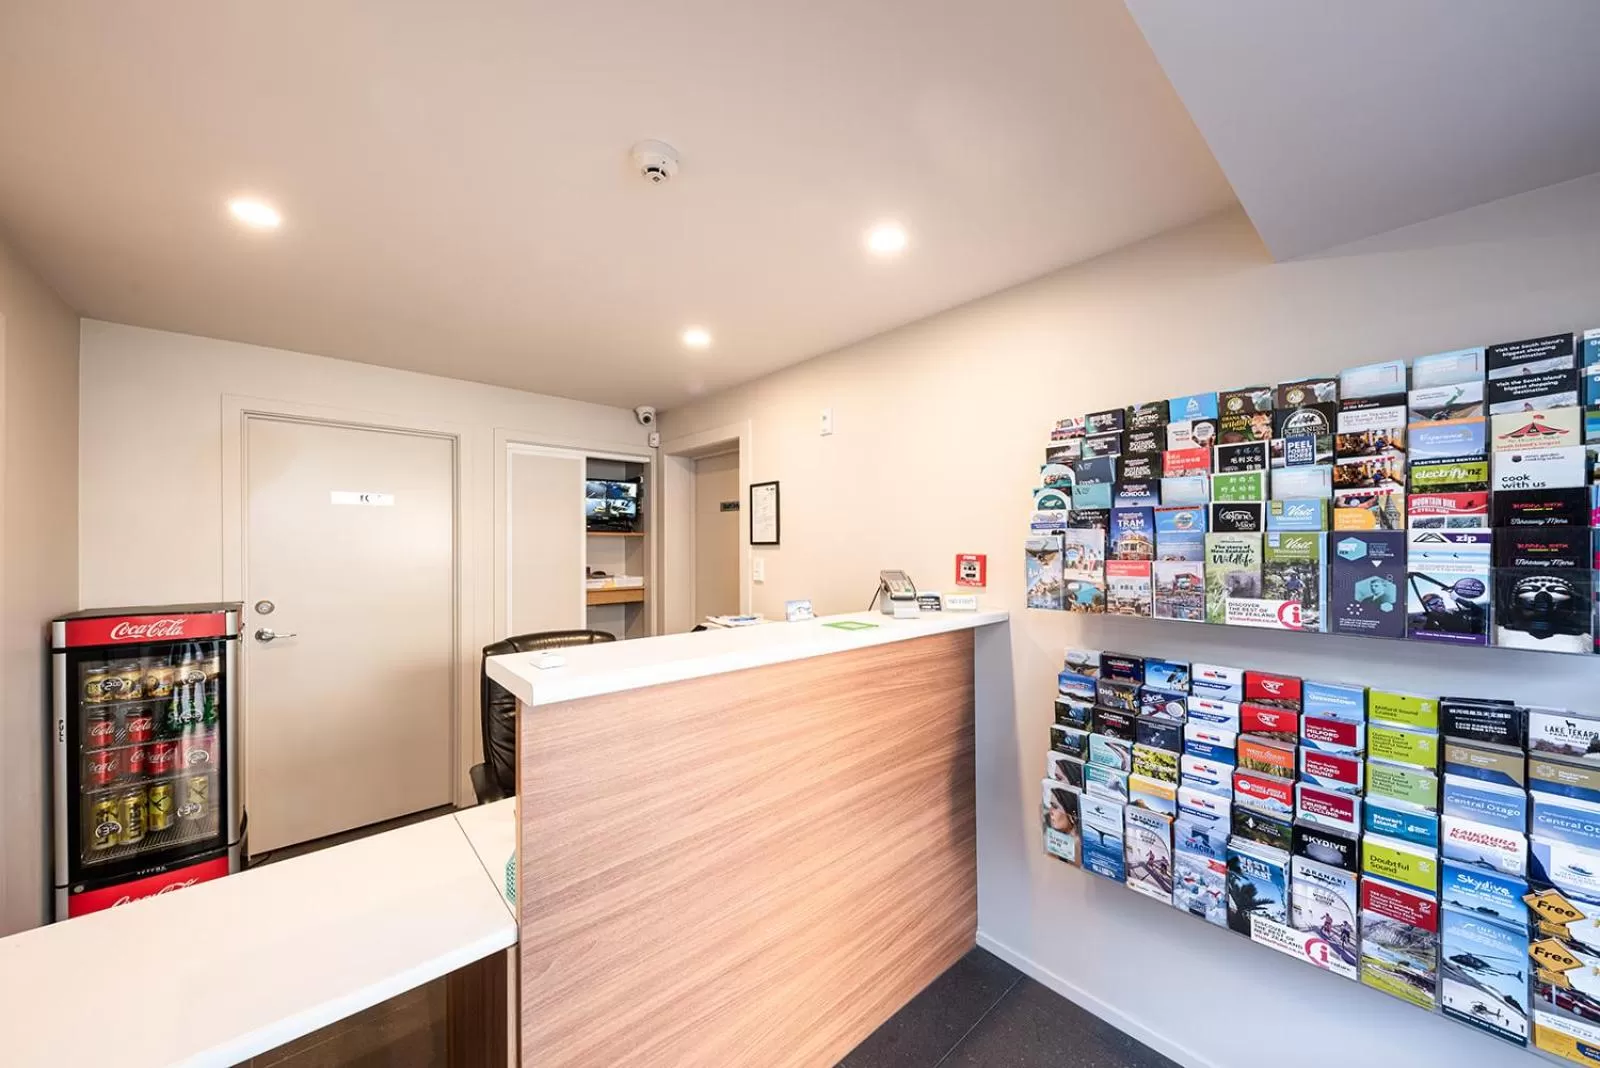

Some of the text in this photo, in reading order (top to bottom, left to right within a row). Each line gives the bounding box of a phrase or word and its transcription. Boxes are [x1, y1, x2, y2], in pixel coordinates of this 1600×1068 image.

[1287, 441, 1312, 450] PEEL
[1502, 474, 1531, 482] cook
[1502, 481, 1529, 489] with
[1287, 504, 1314, 516] Visit
[1118, 519, 1144, 527] TRAM
[1285, 537, 1313, 549] Visit
[1456, 534, 1477, 544] zip
[1213, 554, 1254, 567] Wildlife
[110, 618, 188, 640] Coca-Cola
[1306, 728, 1340, 739] MILFORD
[1545, 724, 1564, 734] LAKE
[1307, 733, 1333, 742] SOUND
[1307, 763, 1340, 775] MILFORD
[1308, 769, 1334, 778] SOUND
[1308, 806, 1338, 818] CYCLING
[1448, 795, 1484, 809] Central
[1487, 802, 1521, 817] Otago
[1539, 815, 1581, 830] Central
[1302, 834, 1347, 853] SKYDIVE
[1452, 828, 1517, 847] KAIKOURA
[1370, 855, 1410, 871] Doubtful
[1370, 861, 1397, 874] Sound
[1300, 866, 1346, 885] TARANAKI
[1457, 874, 1510, 896] Skydive
[1537, 900, 1576, 918] Free
[1534, 946, 1574, 966] Free
